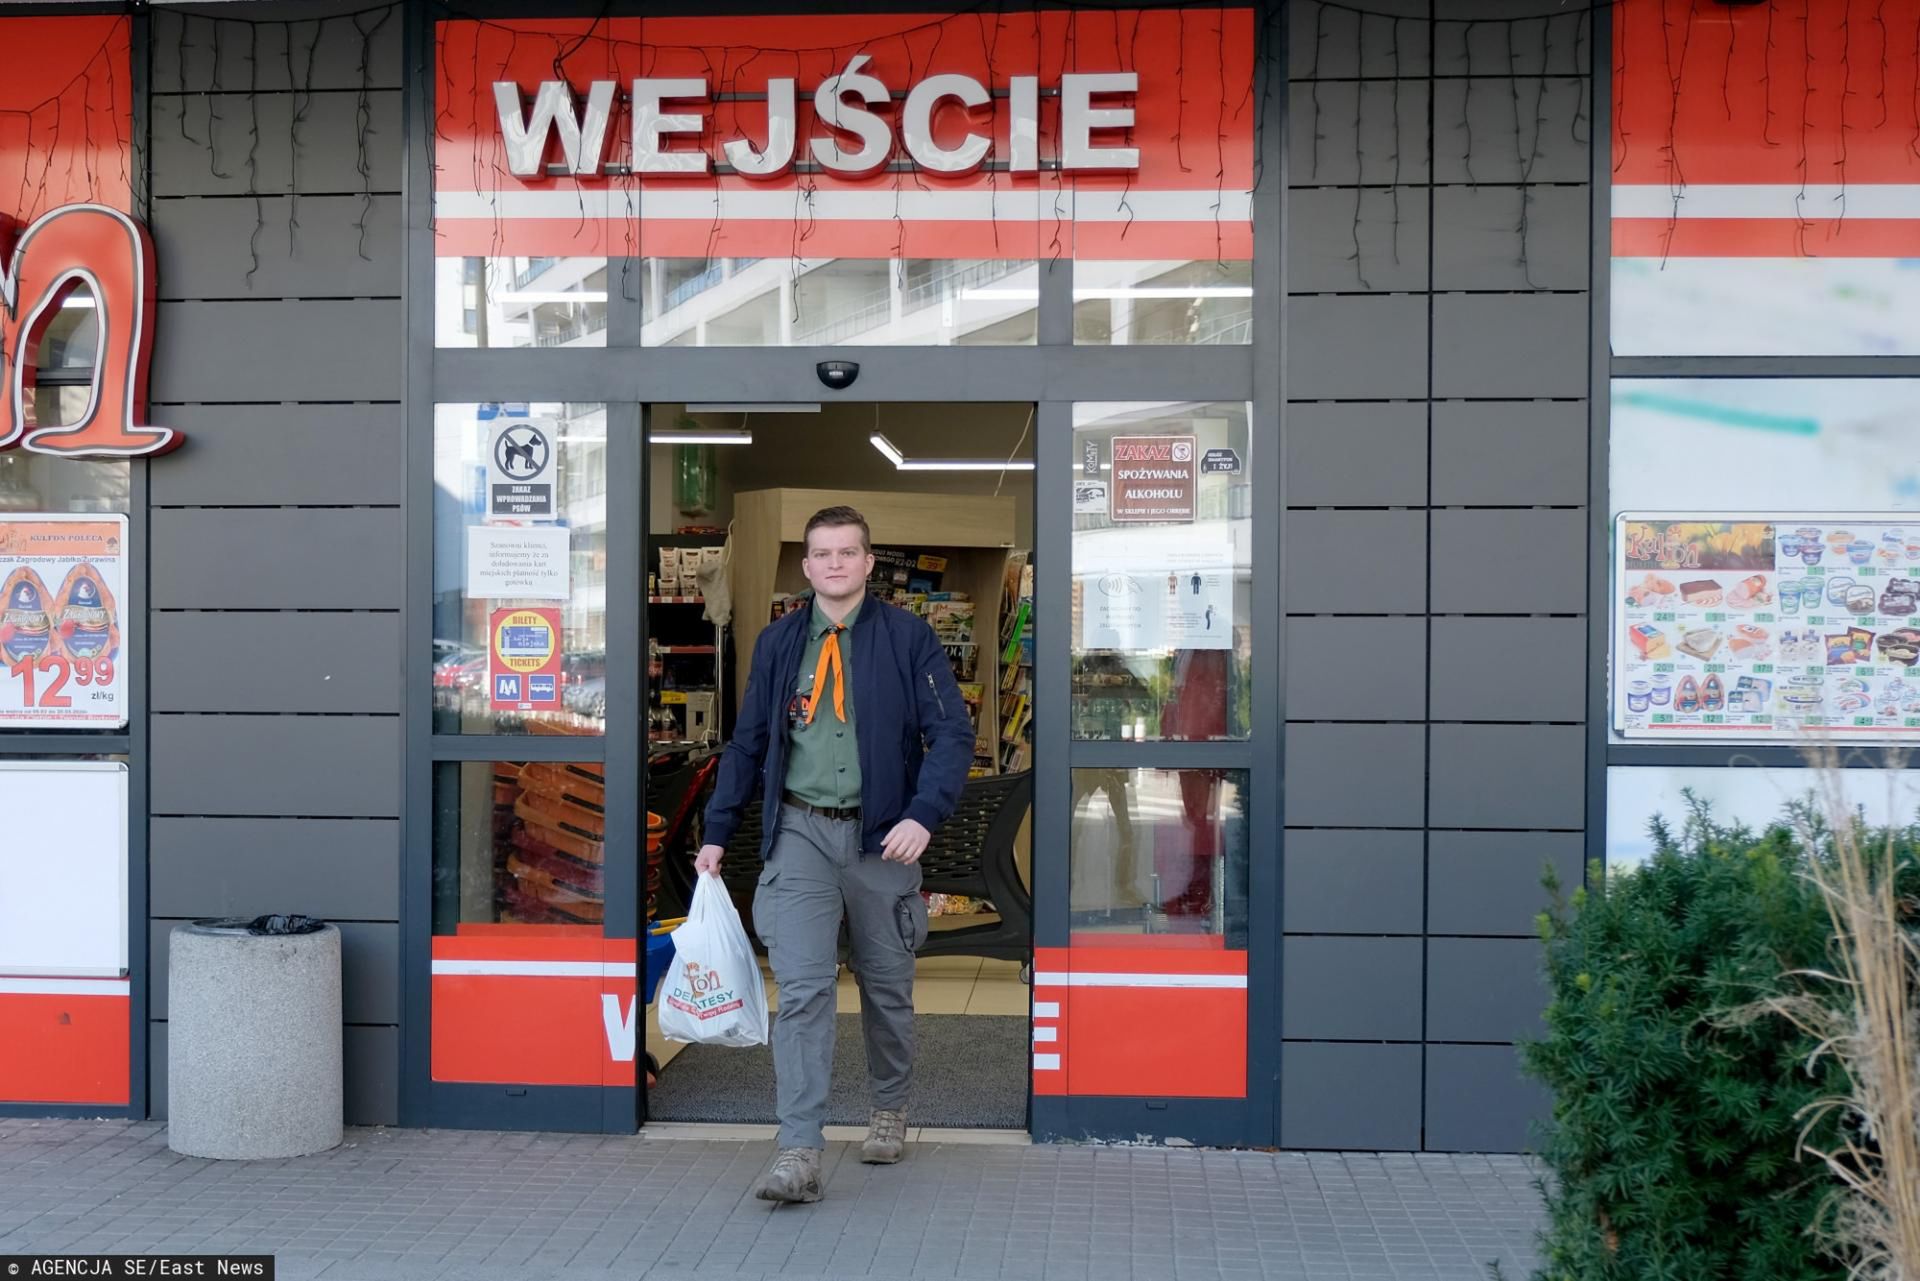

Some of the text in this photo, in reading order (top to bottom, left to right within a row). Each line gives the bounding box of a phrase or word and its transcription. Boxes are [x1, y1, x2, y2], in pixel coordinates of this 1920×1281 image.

[492, 55, 1140, 181] WEJŚCIE
[1115, 445, 1171, 461] ZAKAZ
[1117, 467, 1189, 480] SPOŻYWANIA
[511, 485, 531, 494] ZAKAZ
[1124, 488, 1183, 500] ALKOHOLU
[496, 495, 547, 503] WPROWADZANIA
[512, 503, 531, 513] PSÓW
[16, 556, 56, 564] Zagrodowy
[512, 616, 538, 625] BILETY
[510, 658, 540, 667] TICKETS
[11, 655, 114, 707] 12 99
[91, 690, 115, 701] zł/kg
